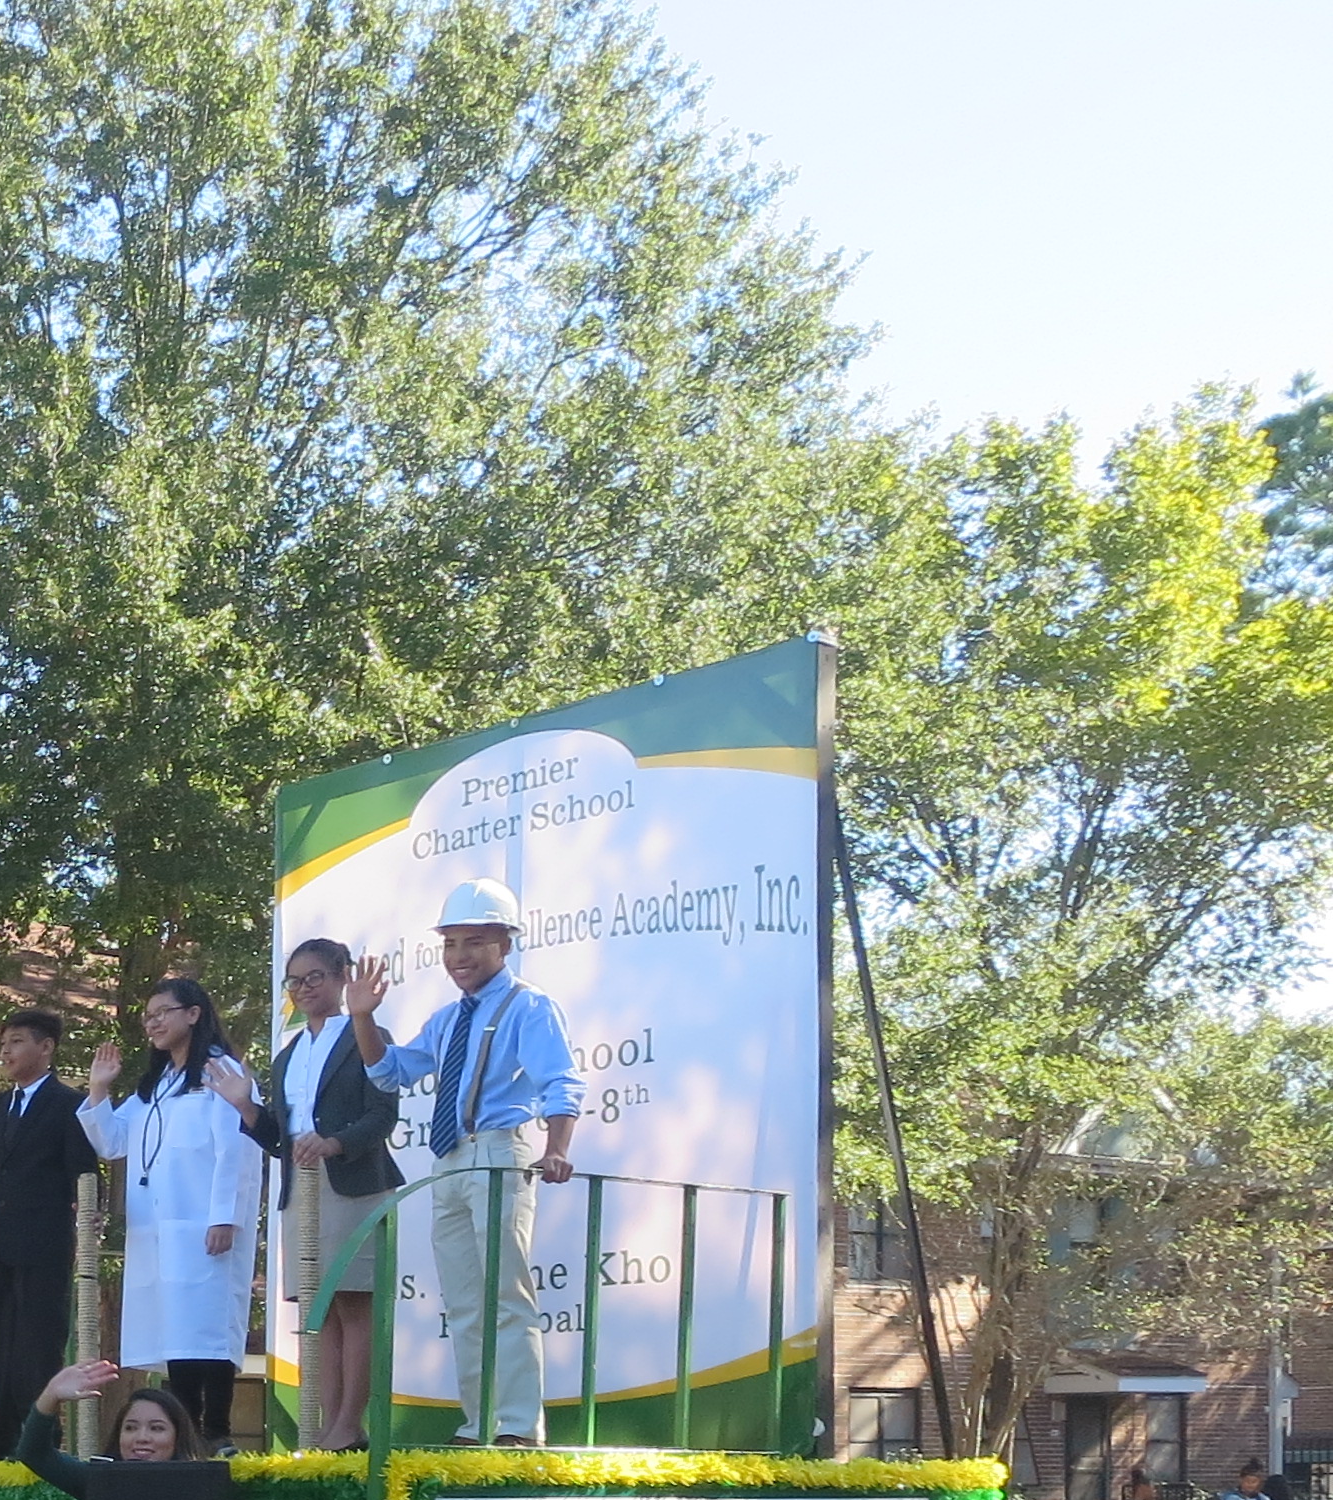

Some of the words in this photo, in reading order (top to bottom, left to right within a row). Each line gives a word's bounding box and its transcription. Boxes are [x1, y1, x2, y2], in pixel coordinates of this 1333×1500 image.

[461, 756, 580, 808] Premier
[412, 814, 522, 860] Charter
[529, 780, 636, 832] School
[511, 905, 603, 952] ellence
[609, 879, 745, 946] Academy,
[754, 863, 809, 936] Inc.
[567, 1028, 656, 1076] hool
[395, 1274, 426, 1300] s.
